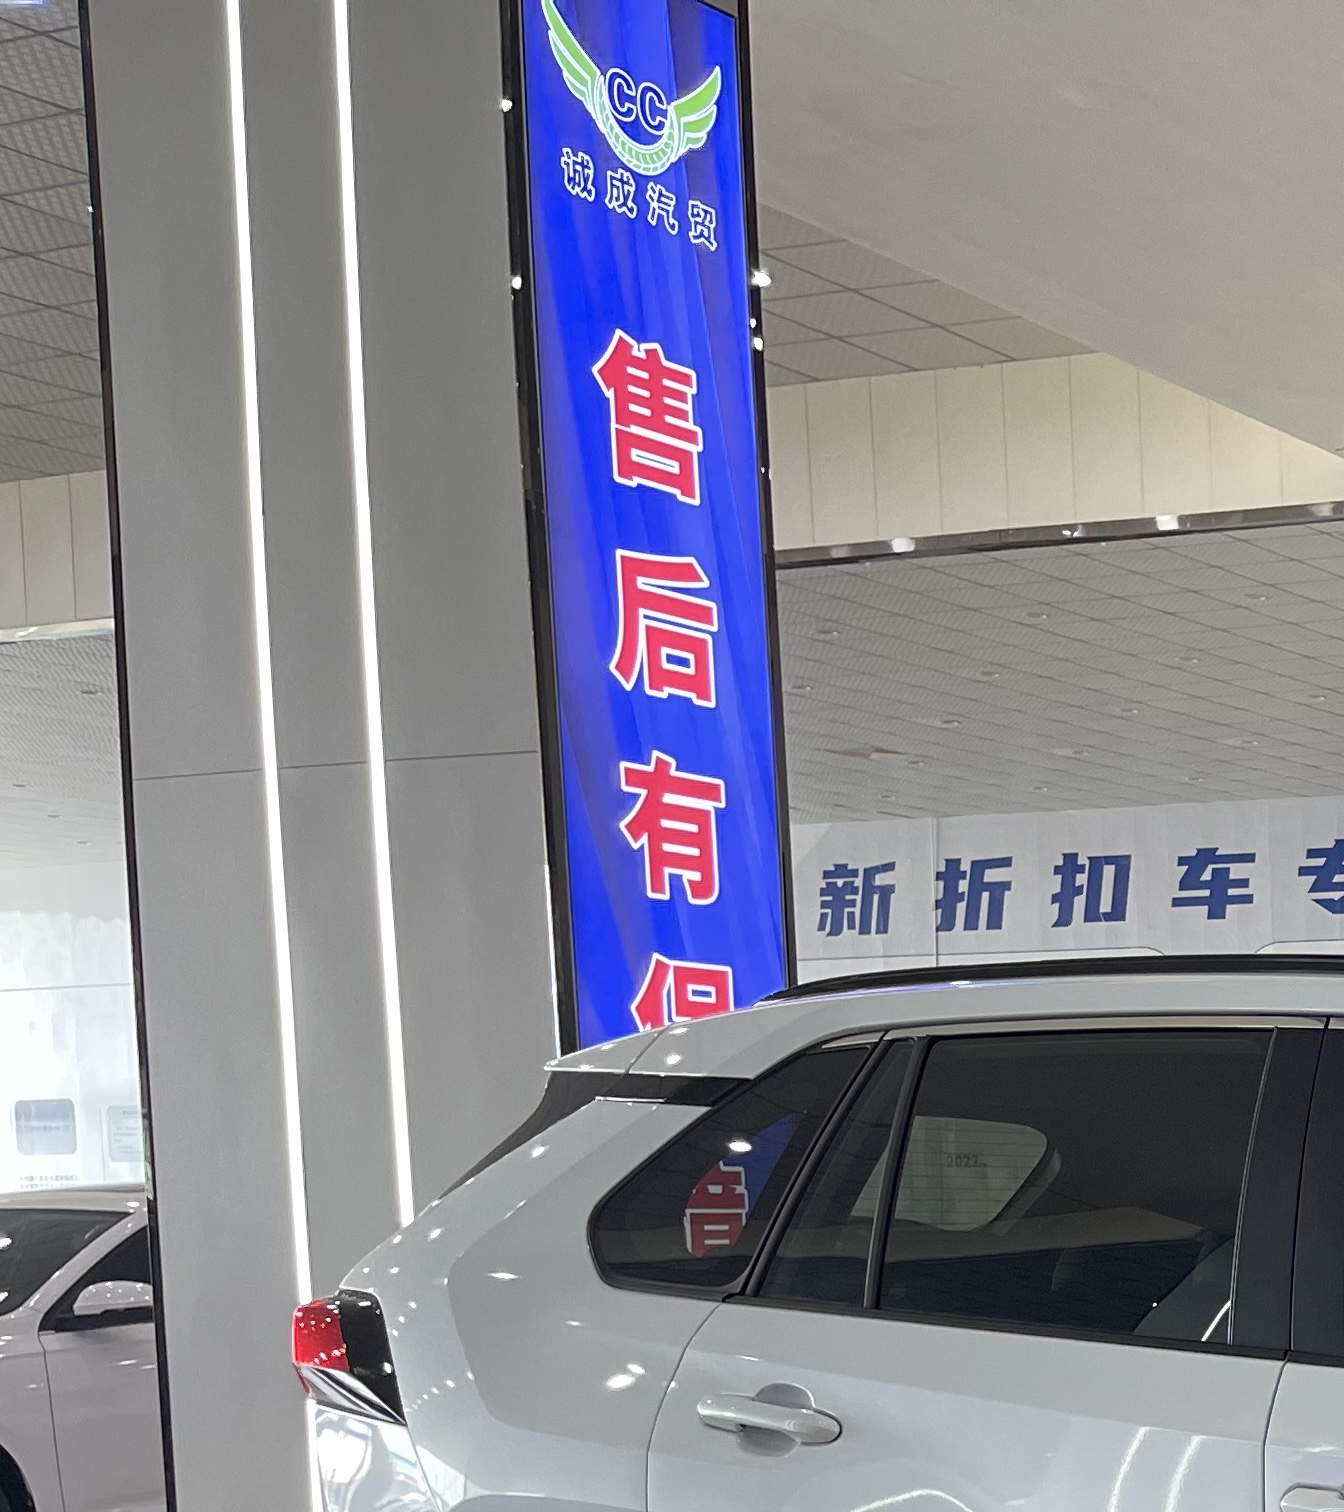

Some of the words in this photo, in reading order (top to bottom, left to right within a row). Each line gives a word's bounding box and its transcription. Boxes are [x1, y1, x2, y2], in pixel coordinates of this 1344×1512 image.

[607, 67, 668, 135] CC
[560, 147, 718, 252] 诚成汽贸
